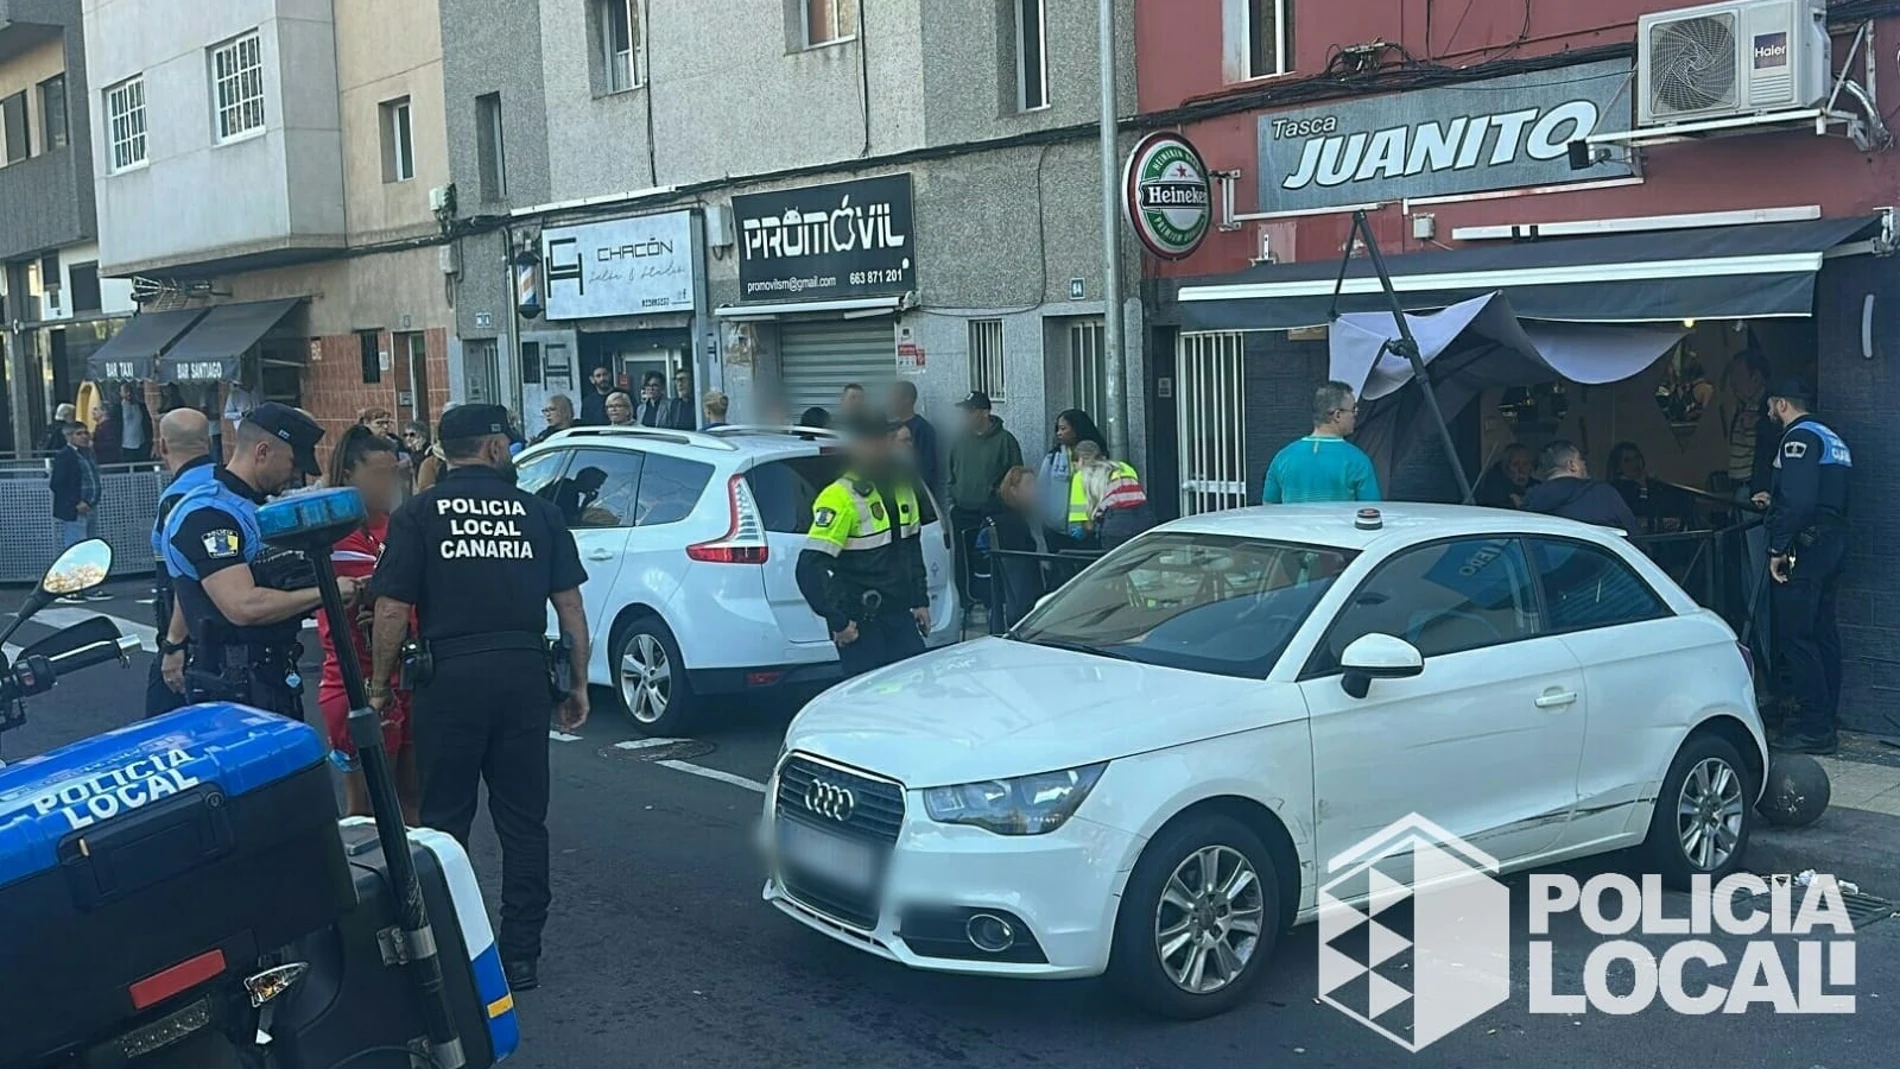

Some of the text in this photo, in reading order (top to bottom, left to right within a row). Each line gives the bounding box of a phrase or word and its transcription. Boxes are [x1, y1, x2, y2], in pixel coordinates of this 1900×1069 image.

[1272, 115, 1337, 139] Tasca
[1282, 99, 1598, 190] JUANITO
[849, 268, 902, 285] 663 871 201
[105, 362, 134, 377] BAR TAXI
[176, 362, 222, 379] BAR SANTIAGO
[436, 498, 527, 516] POLICIA
[450, 519, 522, 537] LOCAL
[440, 539, 534, 559] CANARIA
[61, 768, 200, 830] LOCAL
